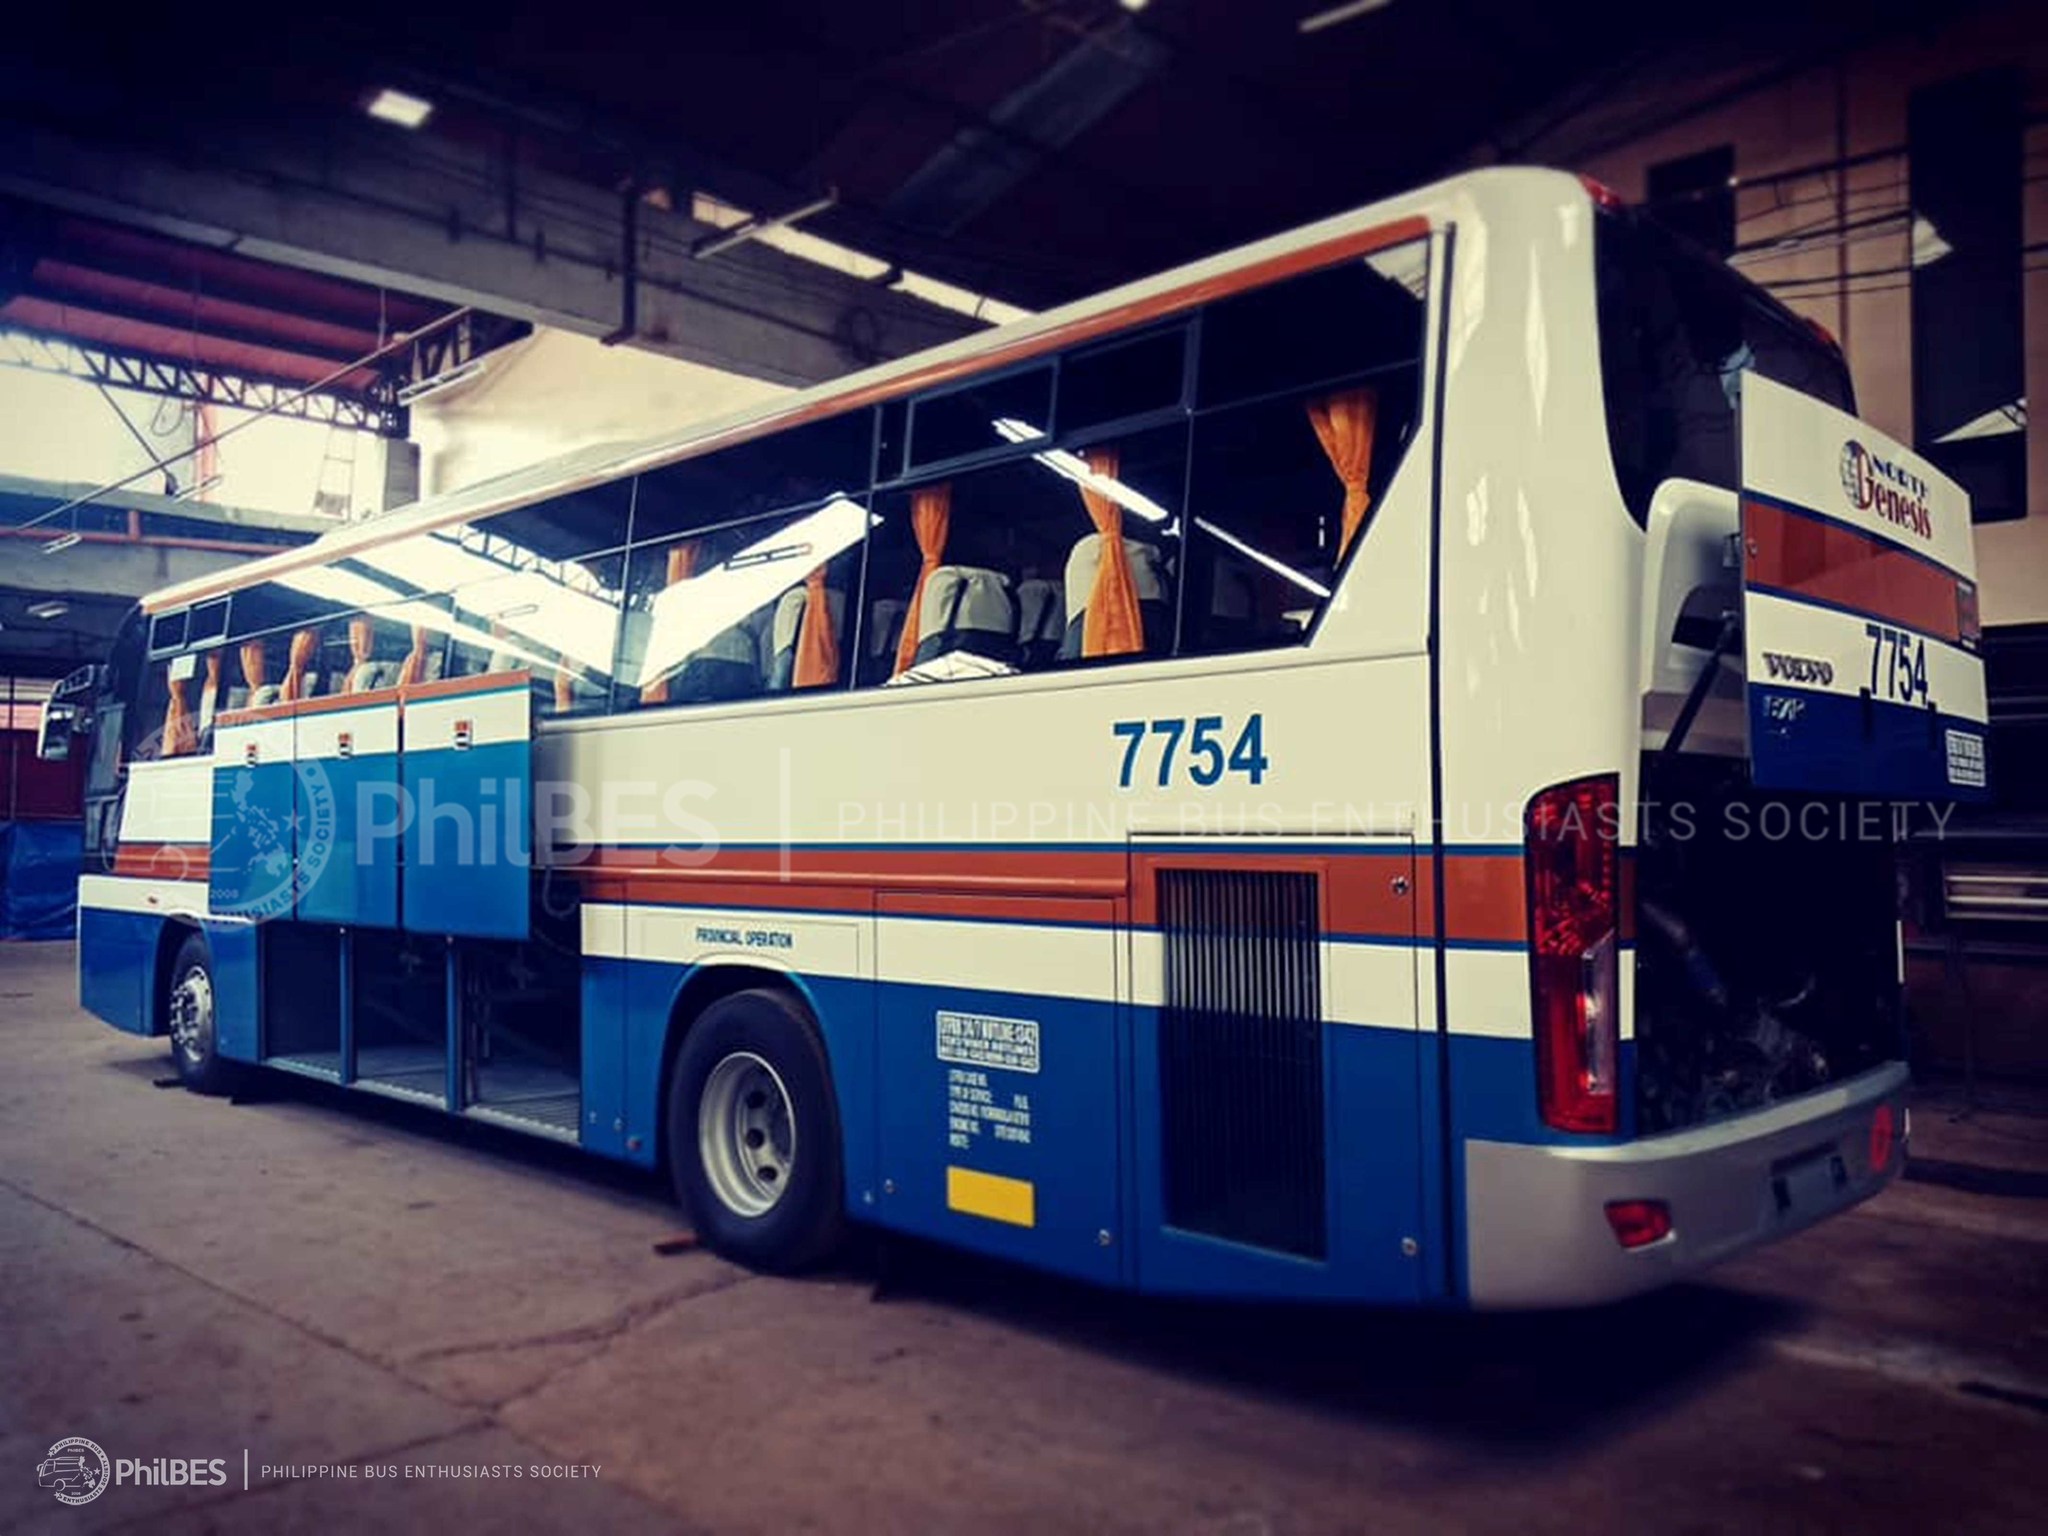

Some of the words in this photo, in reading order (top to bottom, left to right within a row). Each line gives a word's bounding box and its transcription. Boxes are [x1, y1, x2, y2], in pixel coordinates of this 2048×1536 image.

[1856, 441, 1932, 540] Genesis
[1761, 651, 1835, 686] VOLVO
[1865, 622, 1929, 706] 7754
[1112, 712, 1269, 788] 7754
